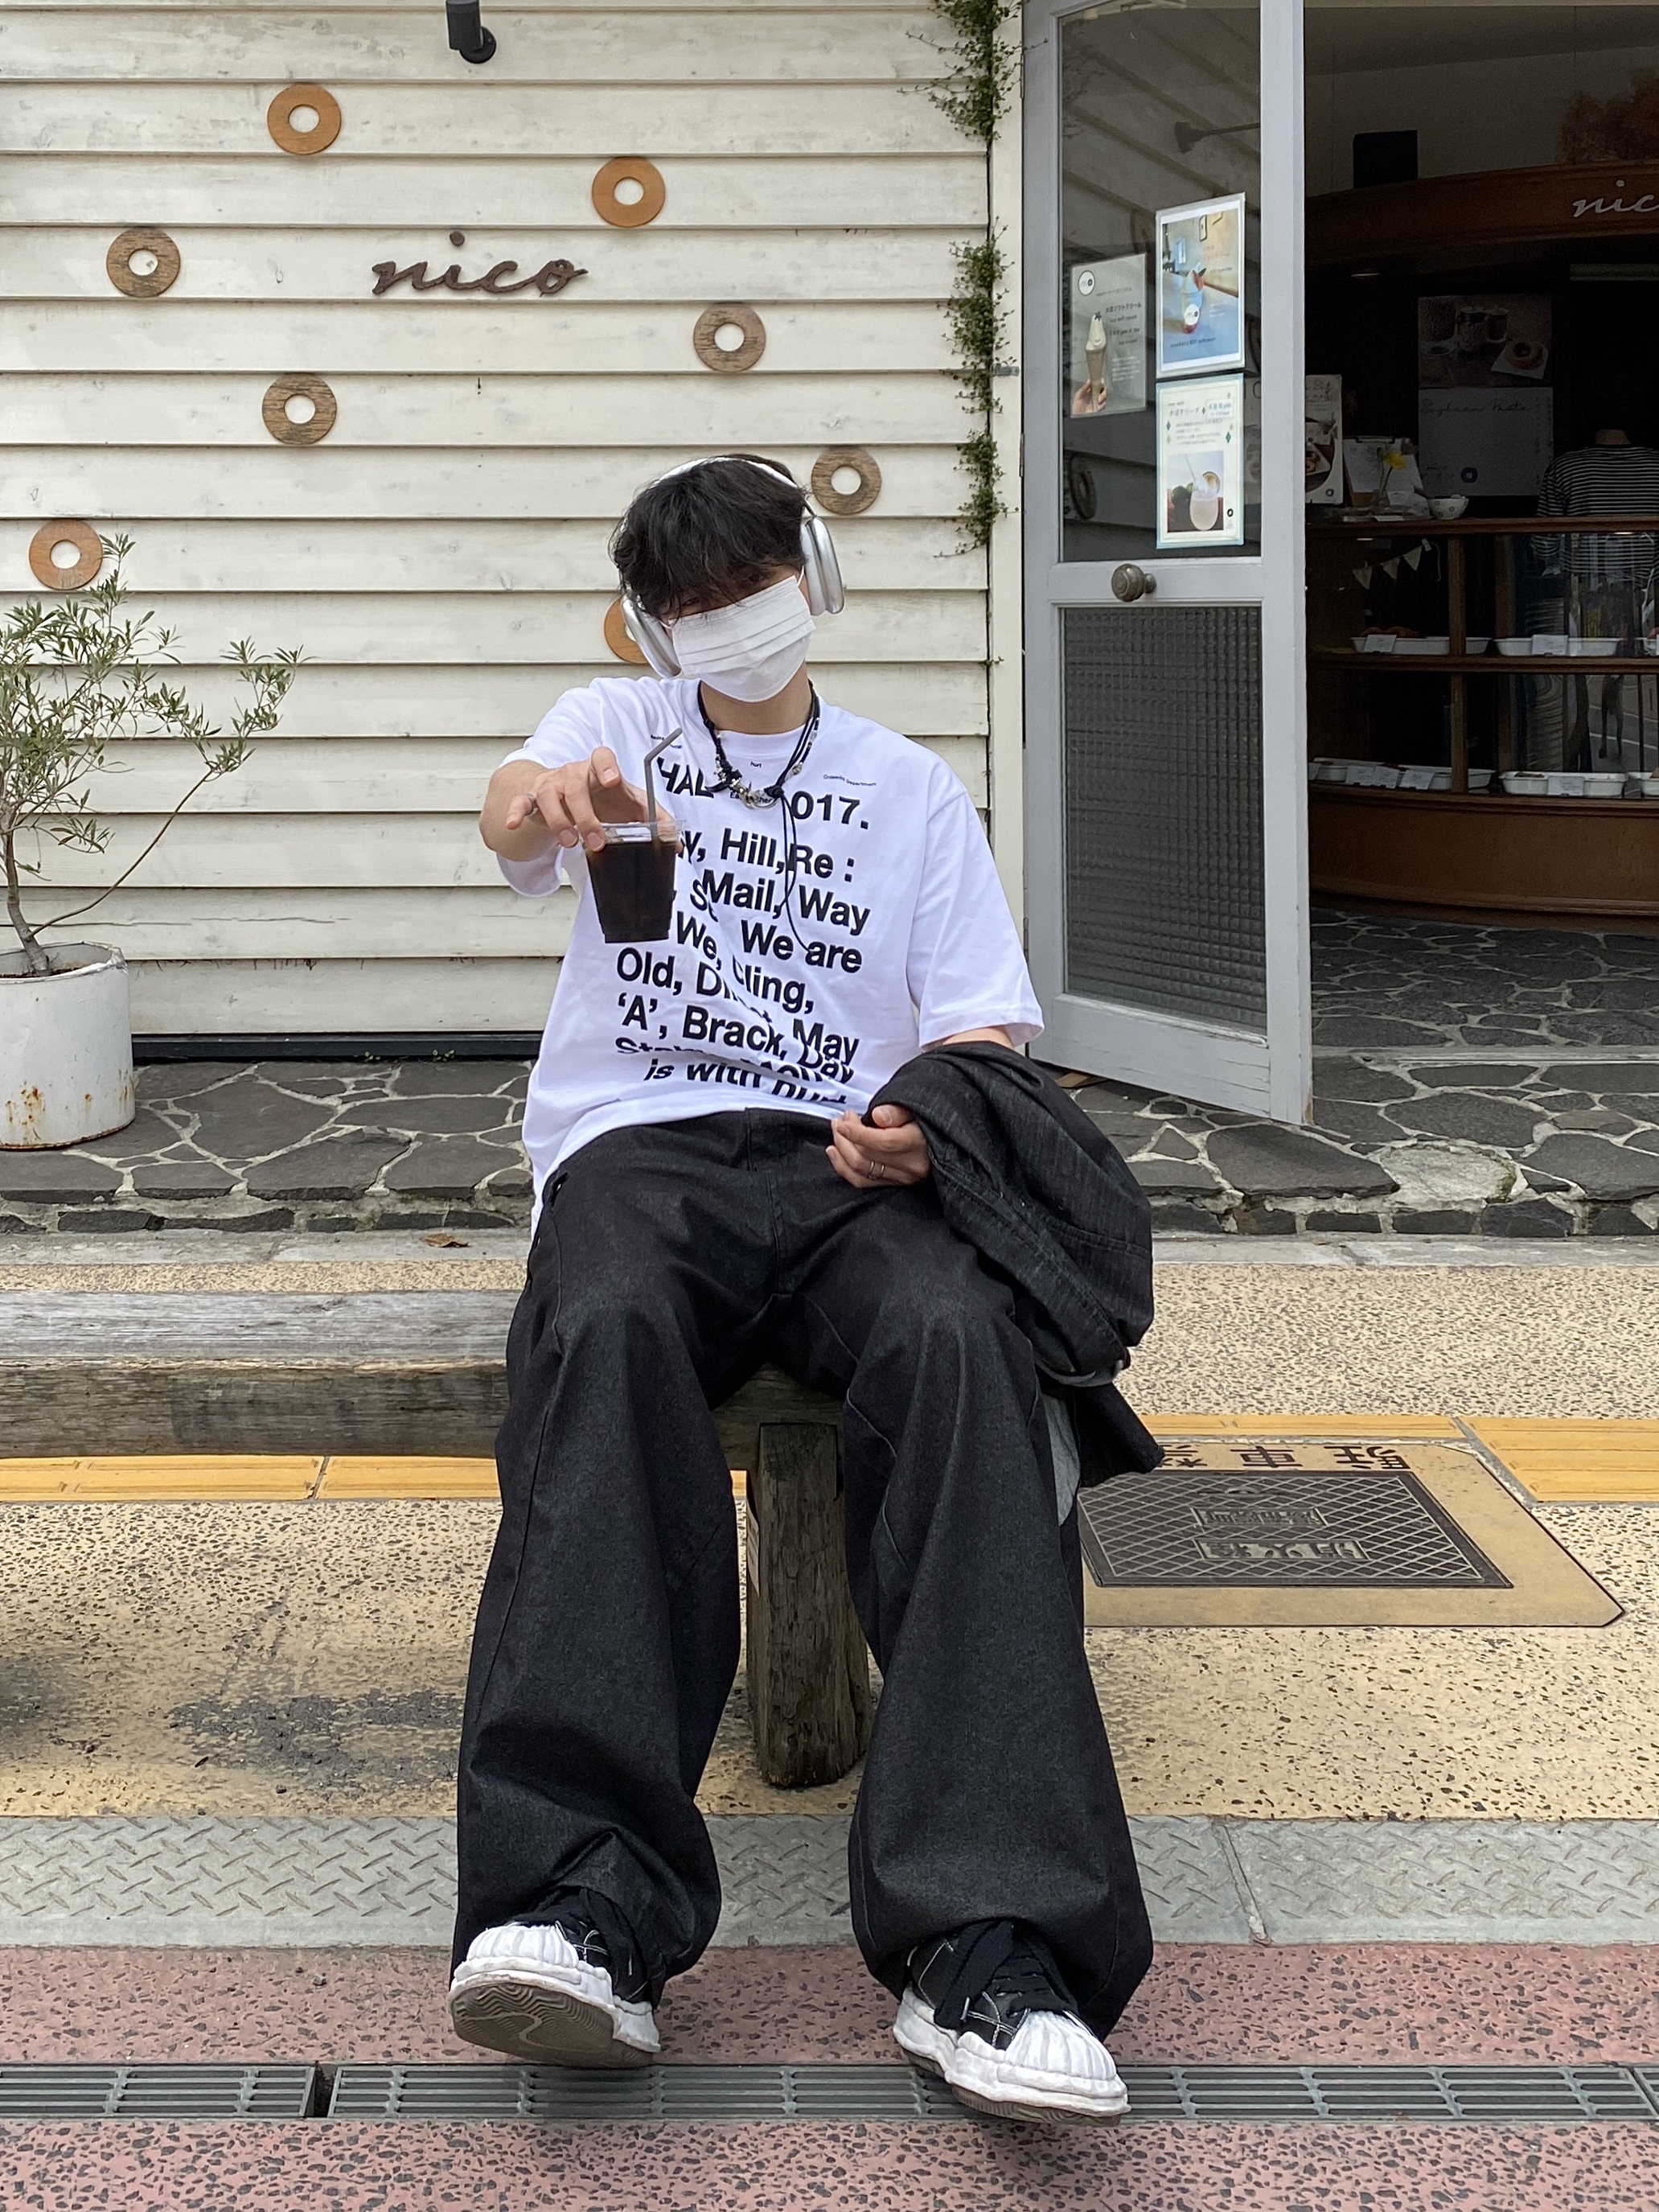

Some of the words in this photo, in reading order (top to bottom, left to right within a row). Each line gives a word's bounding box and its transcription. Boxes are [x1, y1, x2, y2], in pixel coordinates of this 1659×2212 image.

[1572, 179, 1659, 217] nic
[372, 231, 589, 297] nico
[720, 827, 785, 874] Hill,
[786, 842, 834, 879] Re
[701, 869, 782, 920] Mail,
[799, 884, 871, 936] Way
[741, 919, 794, 961] We
[804, 940, 863, 973] are
[616, 947, 683, 997] Old,
[792, 1018, 860, 1067] May
[643, 1058, 675, 1081] is
